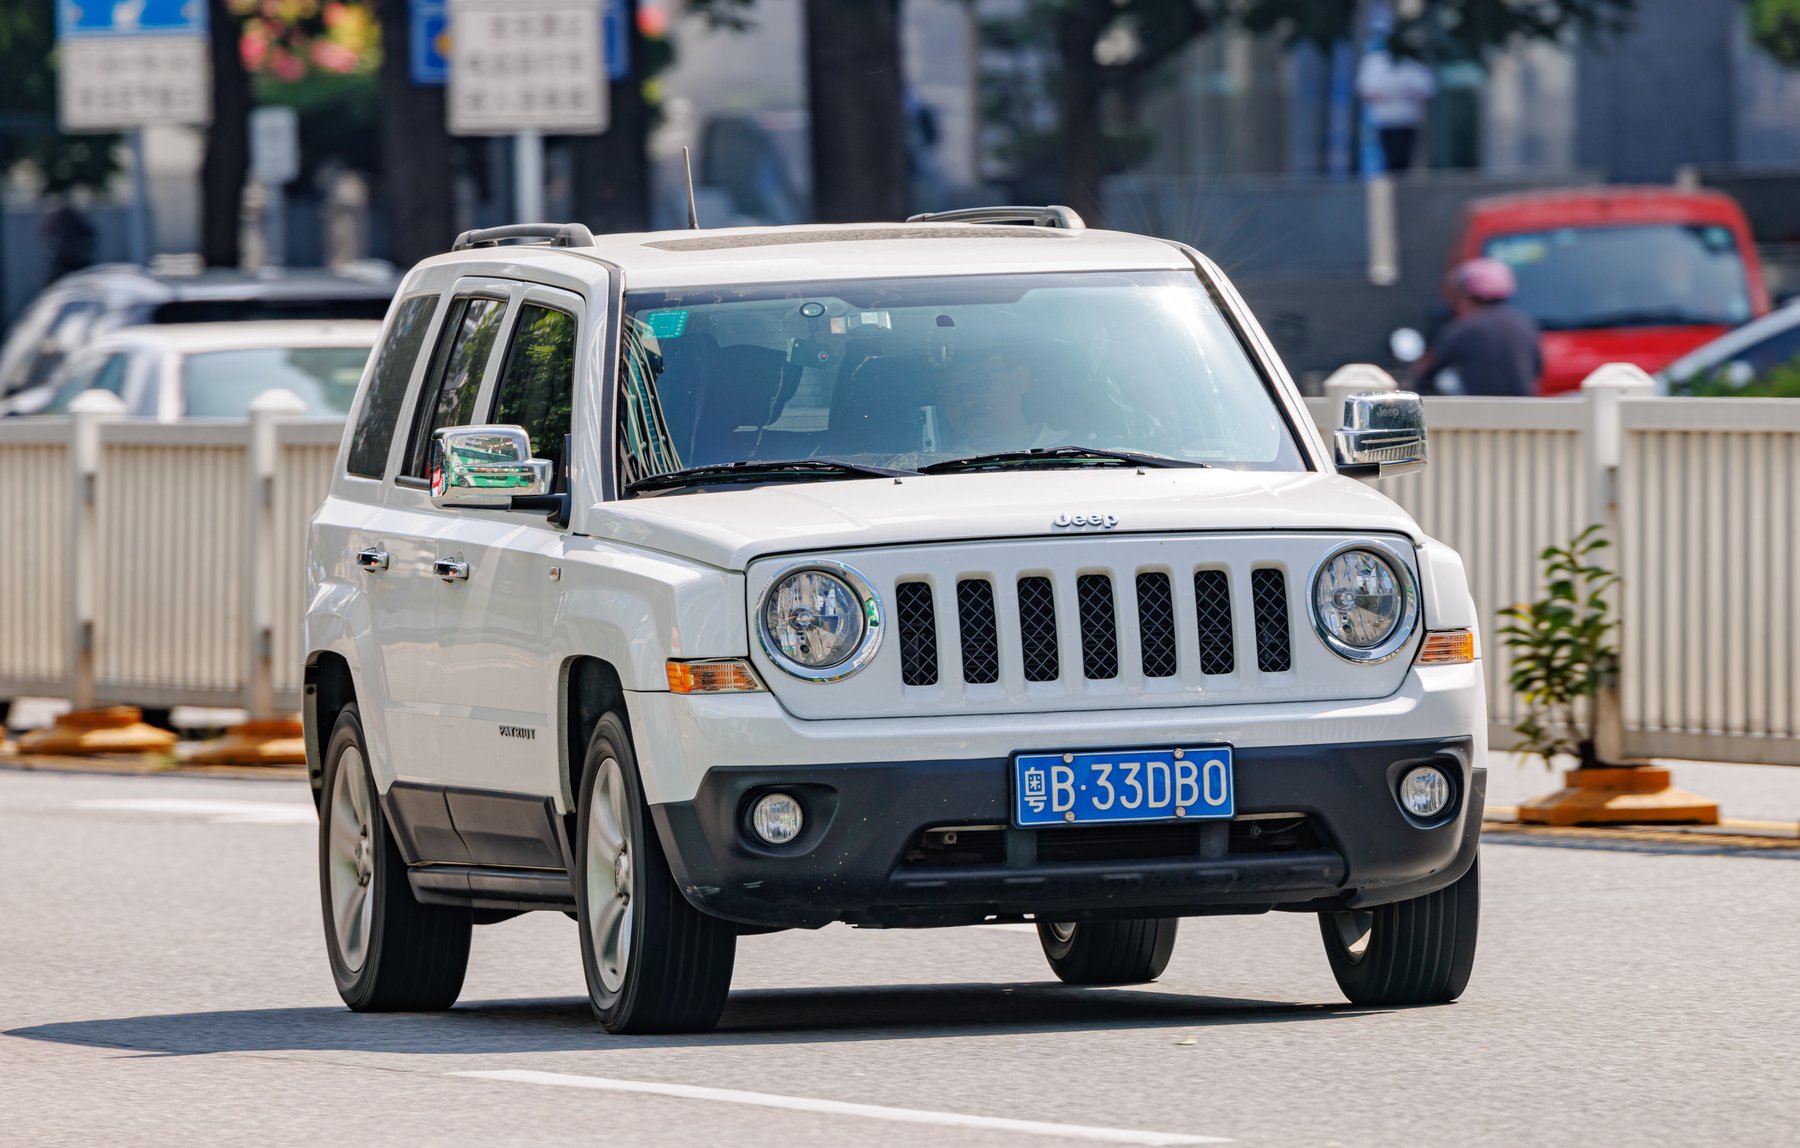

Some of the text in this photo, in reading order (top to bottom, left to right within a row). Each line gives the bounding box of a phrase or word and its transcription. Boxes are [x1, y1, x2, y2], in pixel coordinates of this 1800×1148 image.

[1376, 407, 1399, 418] Jeep
[1054, 511, 1120, 529] Jeep
[499, 725, 536, 740] PATRIOT
